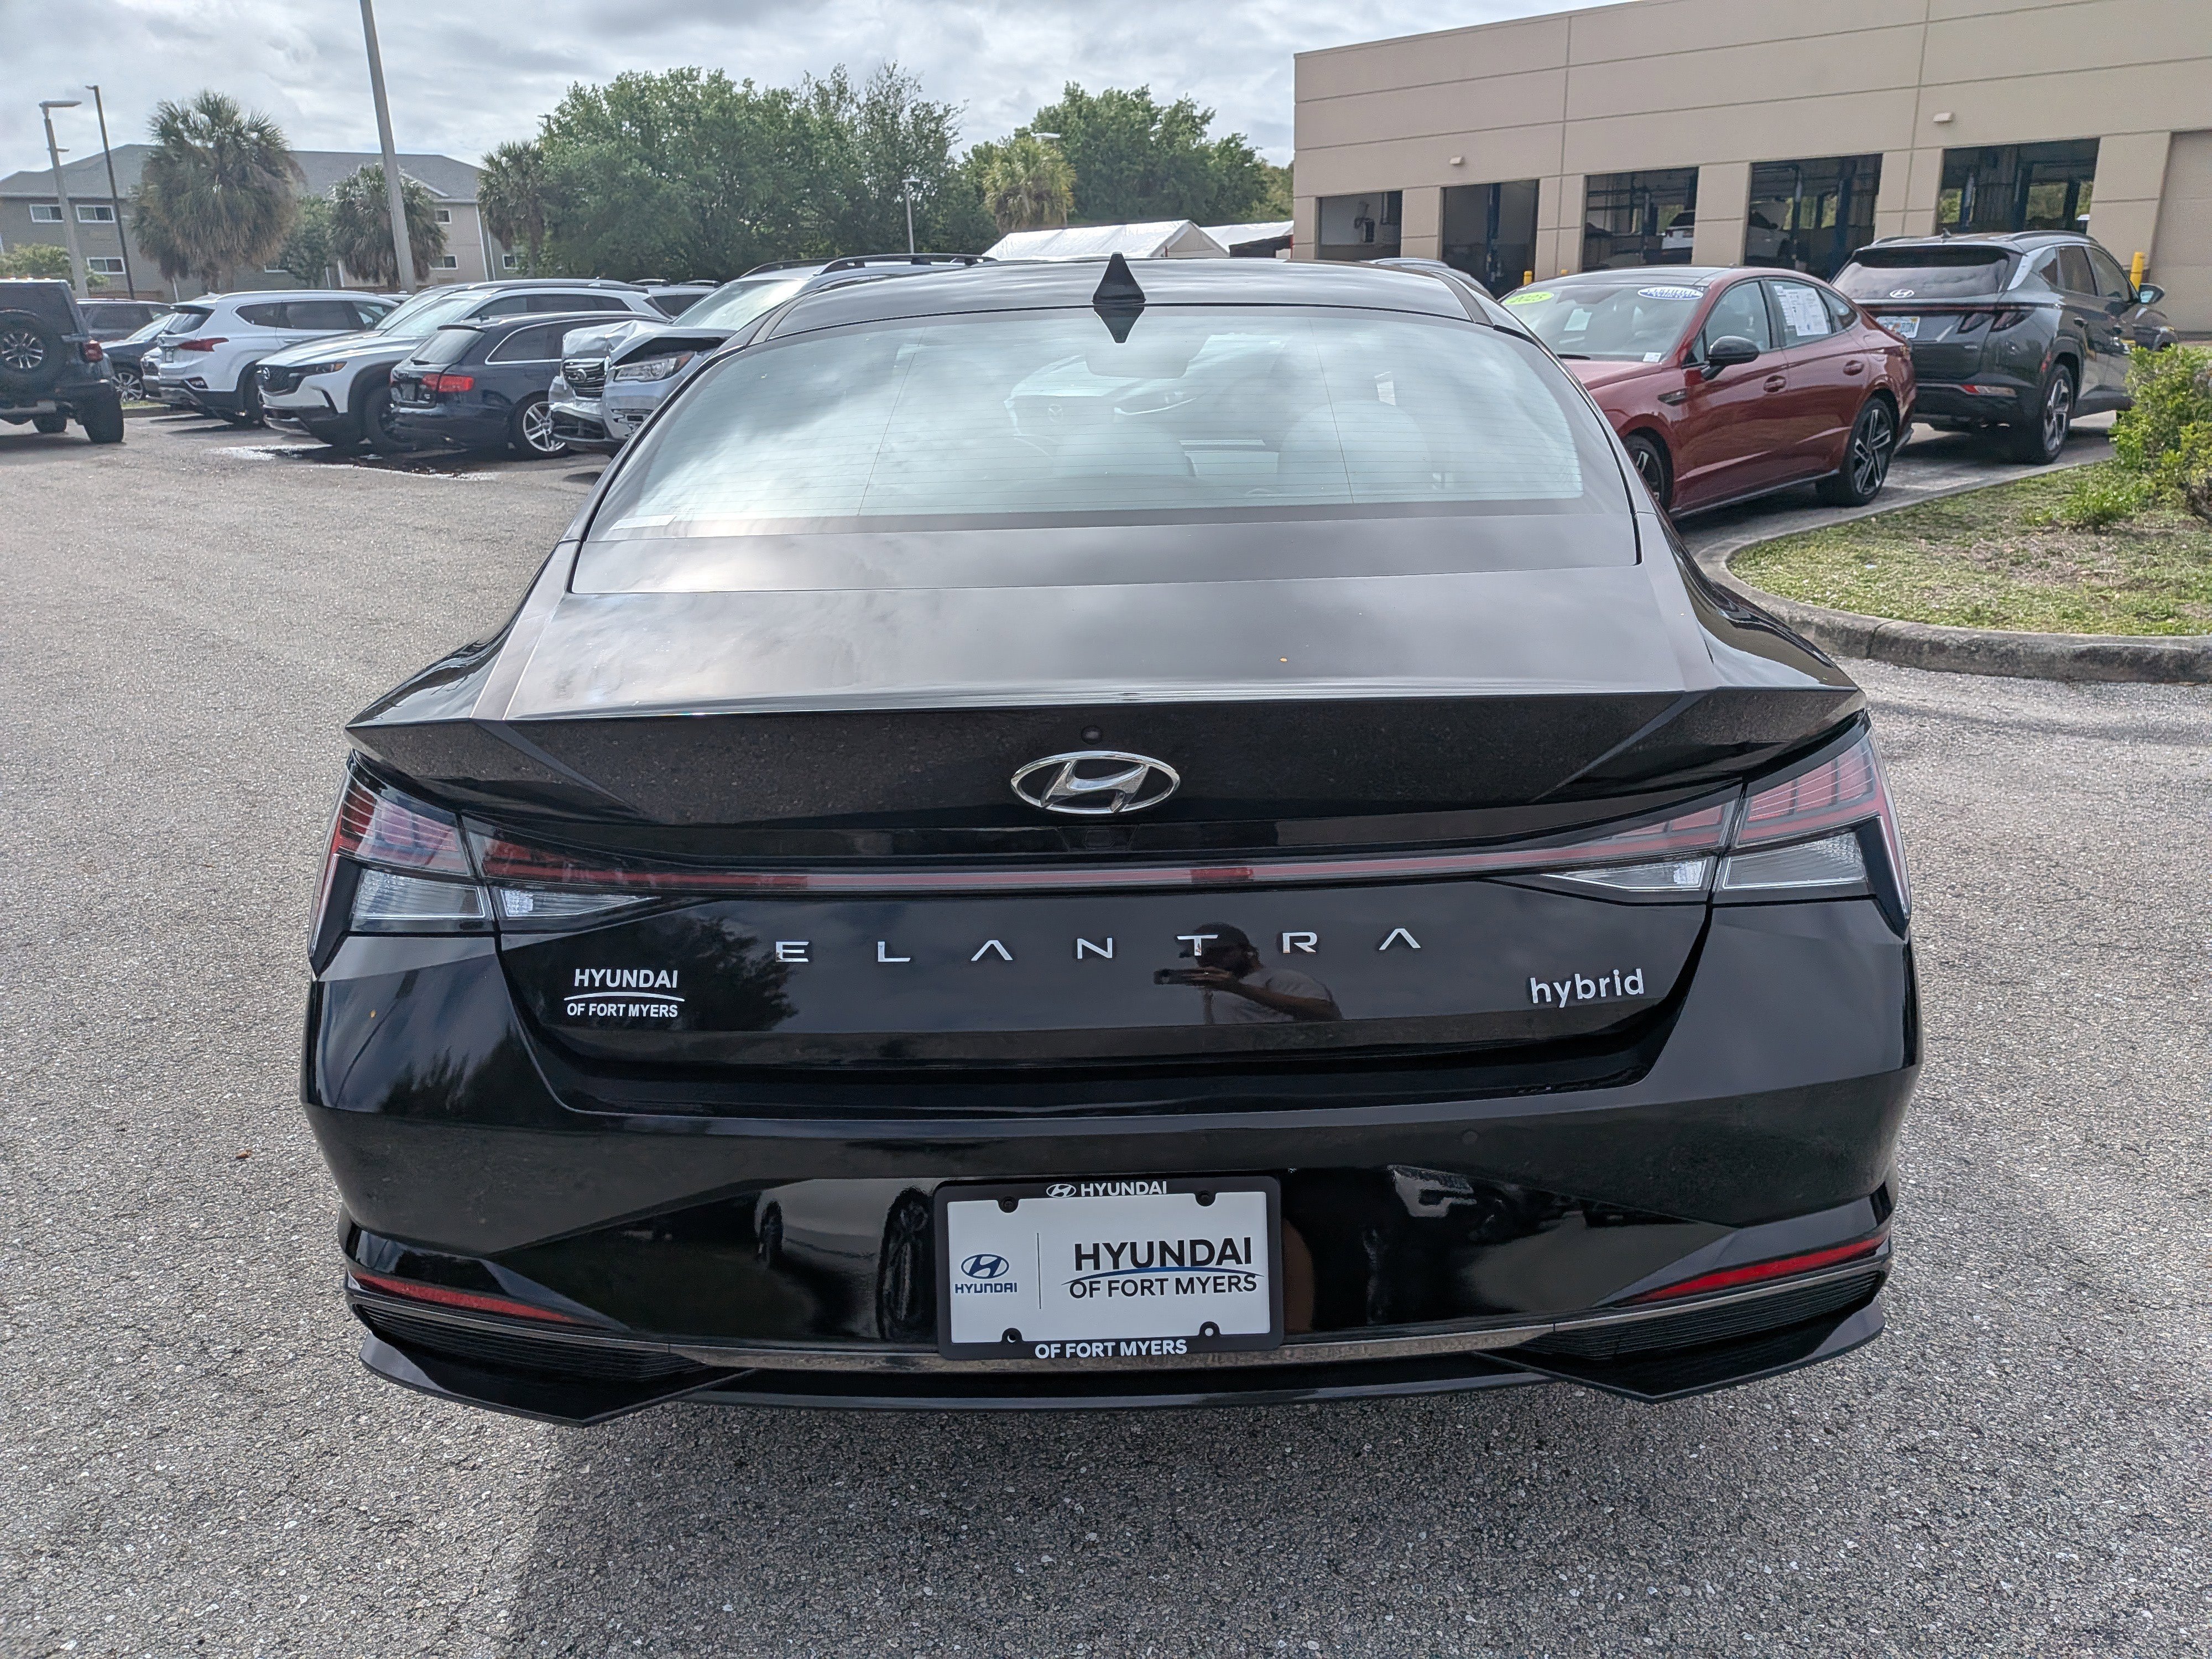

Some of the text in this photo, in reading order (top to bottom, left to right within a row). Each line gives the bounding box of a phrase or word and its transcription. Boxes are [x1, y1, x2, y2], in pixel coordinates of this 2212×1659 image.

[775, 927, 1421, 963] ELANTRA
[574, 969, 678, 988] HYUNDAI
[1530, 968, 1644, 1008] hybrid
[567, 1003, 678, 1018] OF FORT MYERS
[1081, 1181, 1167, 1197] HYUNDAI
[1074, 1237, 1252, 1271] HYUNDAI
[954, 1282, 1018, 1294] HYUNDAI
[1069, 1274, 1257, 1298] OF FORT MYERS
[1035, 1339, 1187, 1359] OF FORT MYERS
